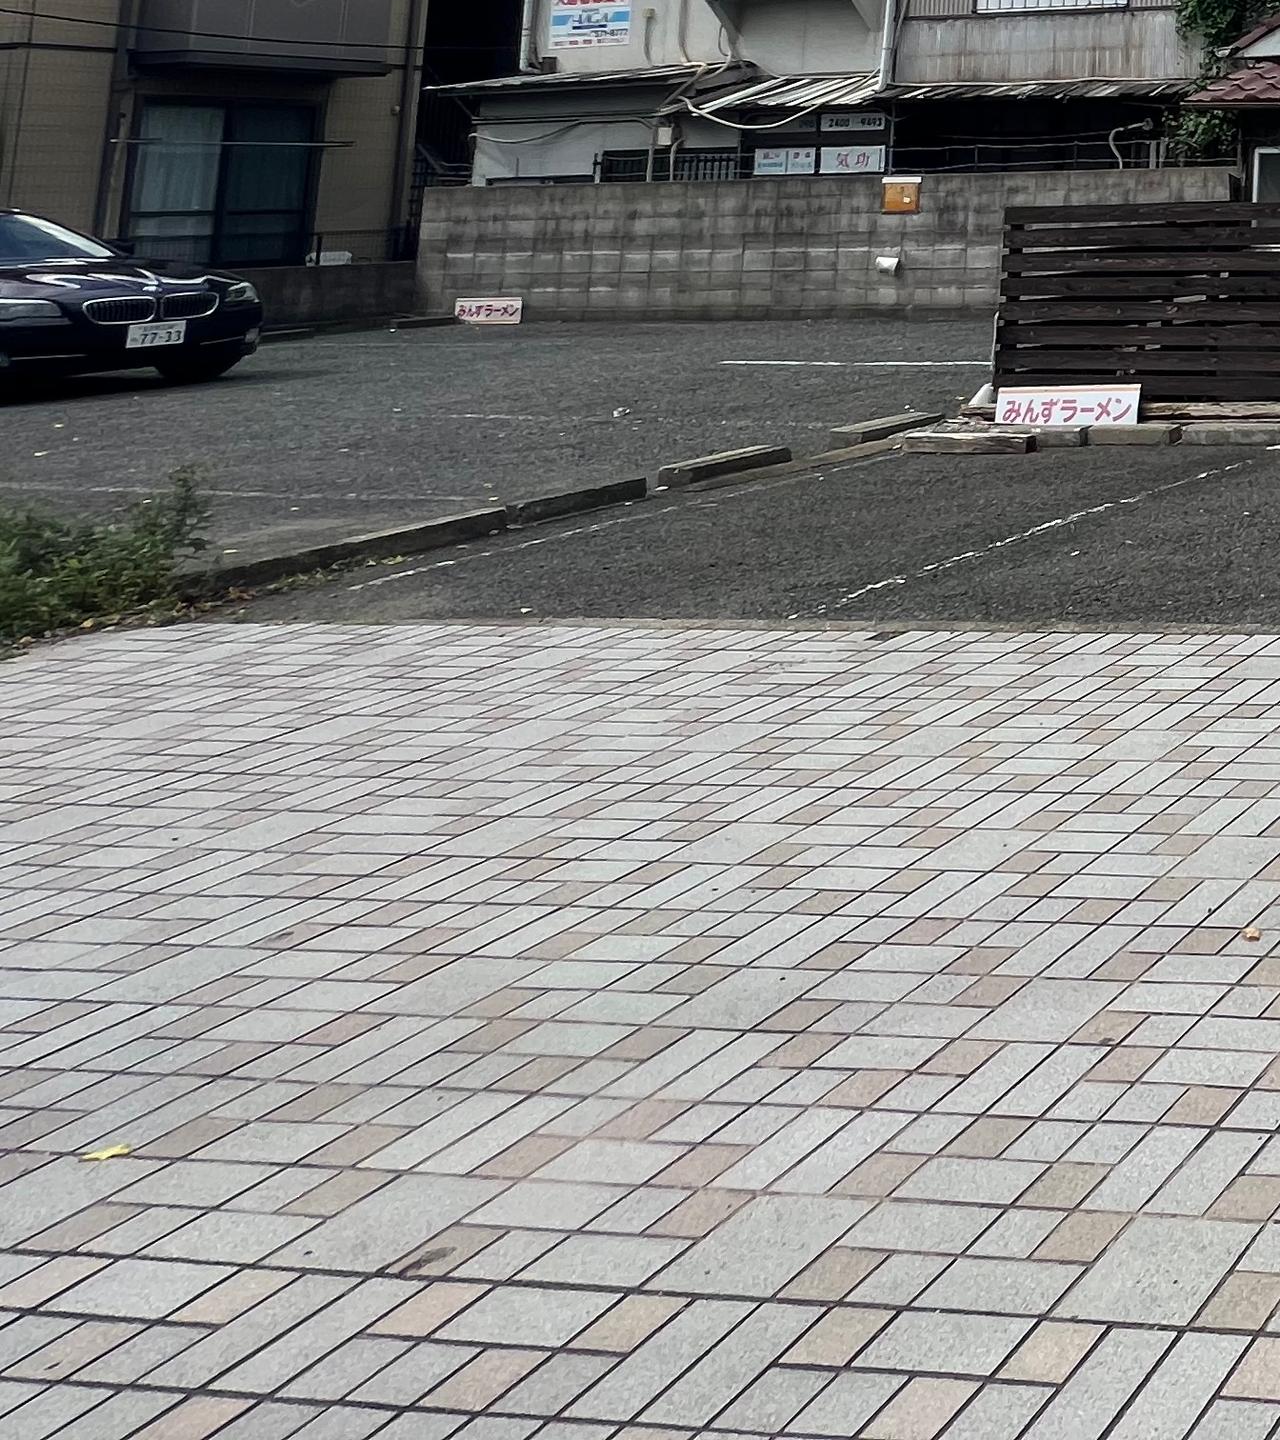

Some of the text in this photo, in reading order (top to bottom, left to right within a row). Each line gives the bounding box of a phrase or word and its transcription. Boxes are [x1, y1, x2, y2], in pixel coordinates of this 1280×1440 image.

[1002, 398, 1133, 424] みんずラーメン
